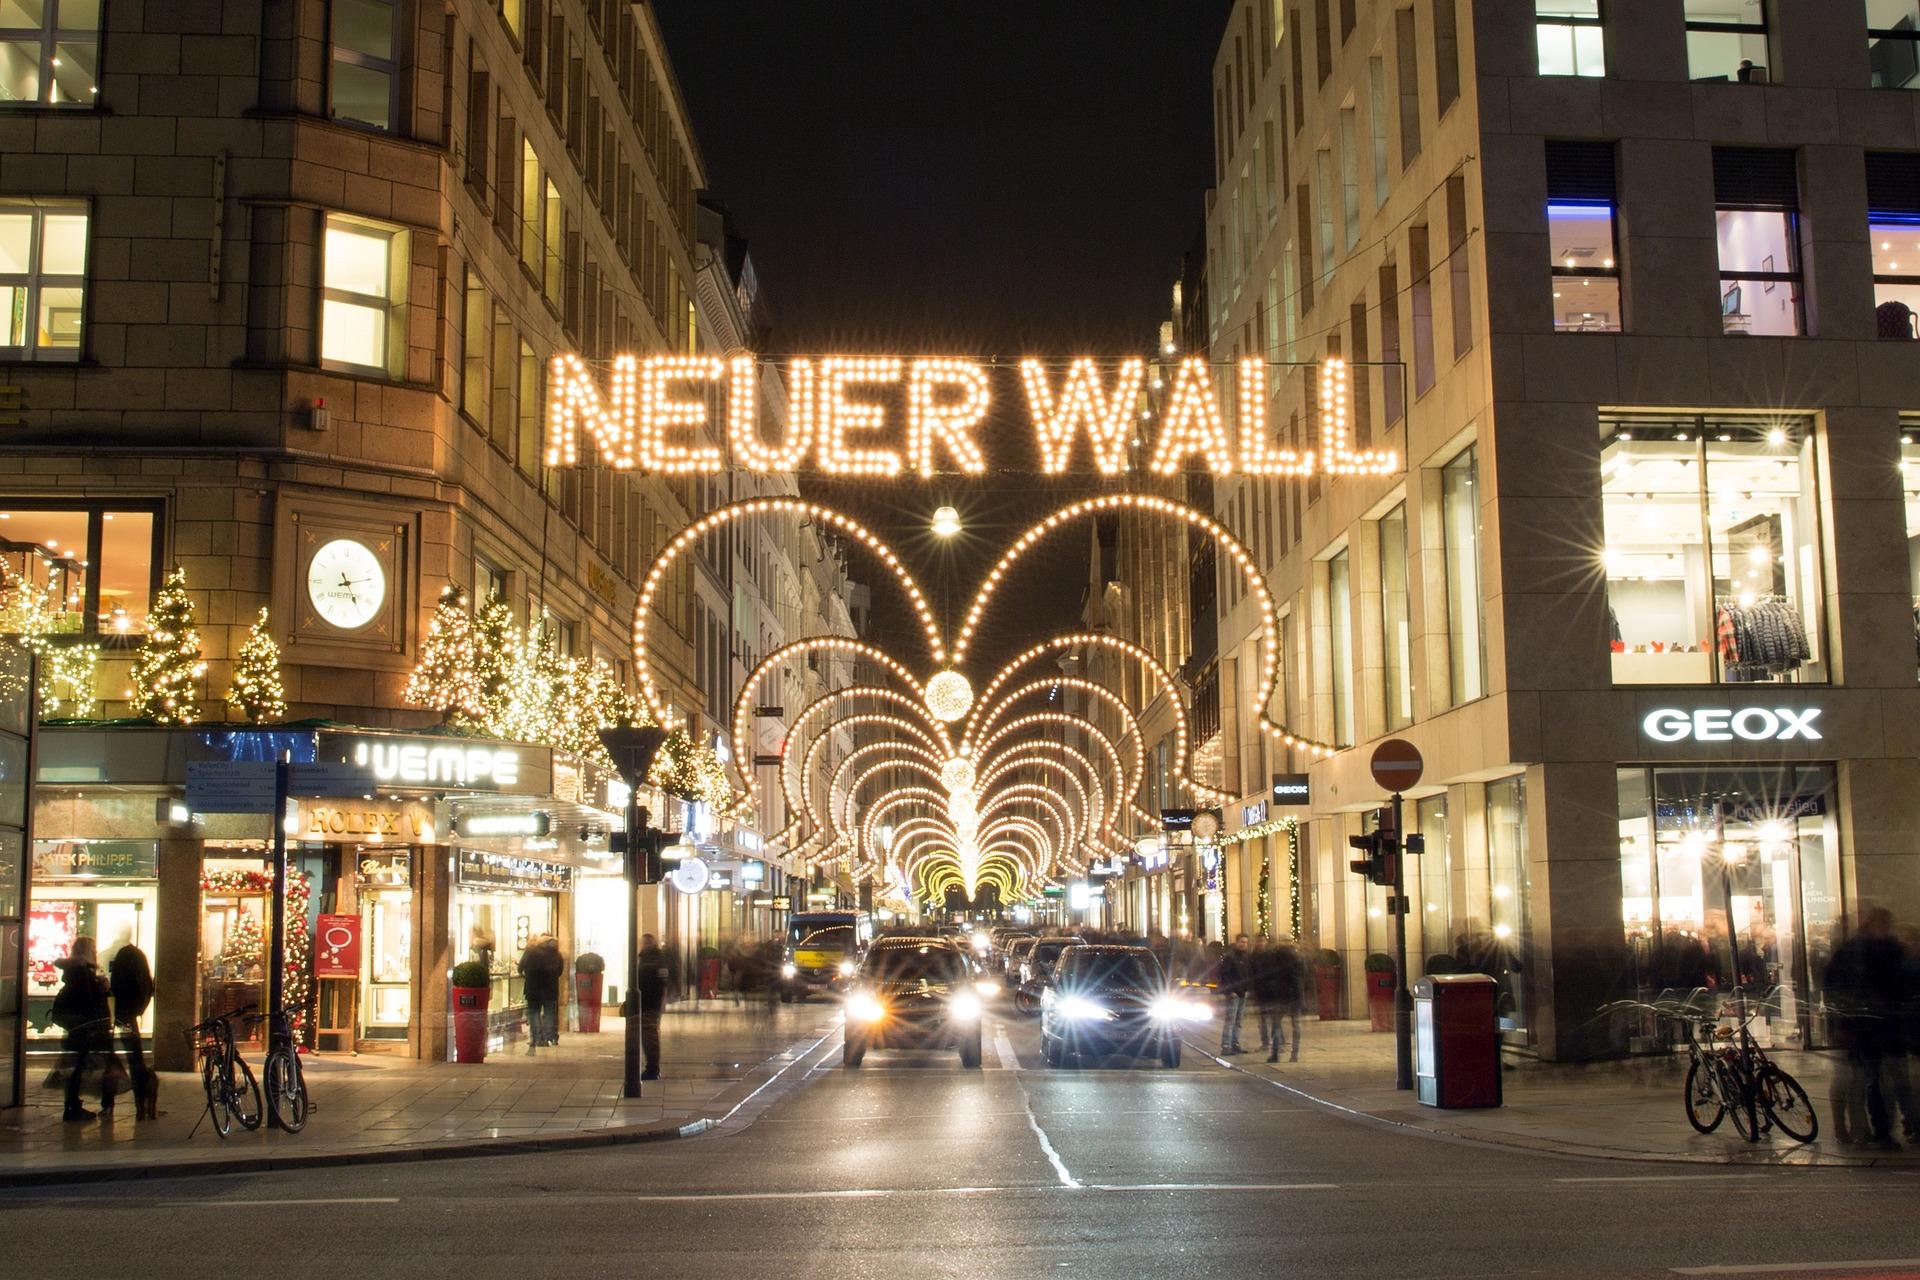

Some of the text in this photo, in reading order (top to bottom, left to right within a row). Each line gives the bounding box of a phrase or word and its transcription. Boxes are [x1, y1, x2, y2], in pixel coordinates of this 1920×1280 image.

[546, 354, 1399, 476] NEUER WALL
[1643, 707, 1823, 742] GEOX
[357, 743, 519, 785] WEMPE
[1274, 785, 1308, 794] GEOX
[310, 807, 400, 835] ROLEX
[1734, 799, 1819, 819] Jungfnstieg
[78, 853, 134, 866] PHILIPPE
